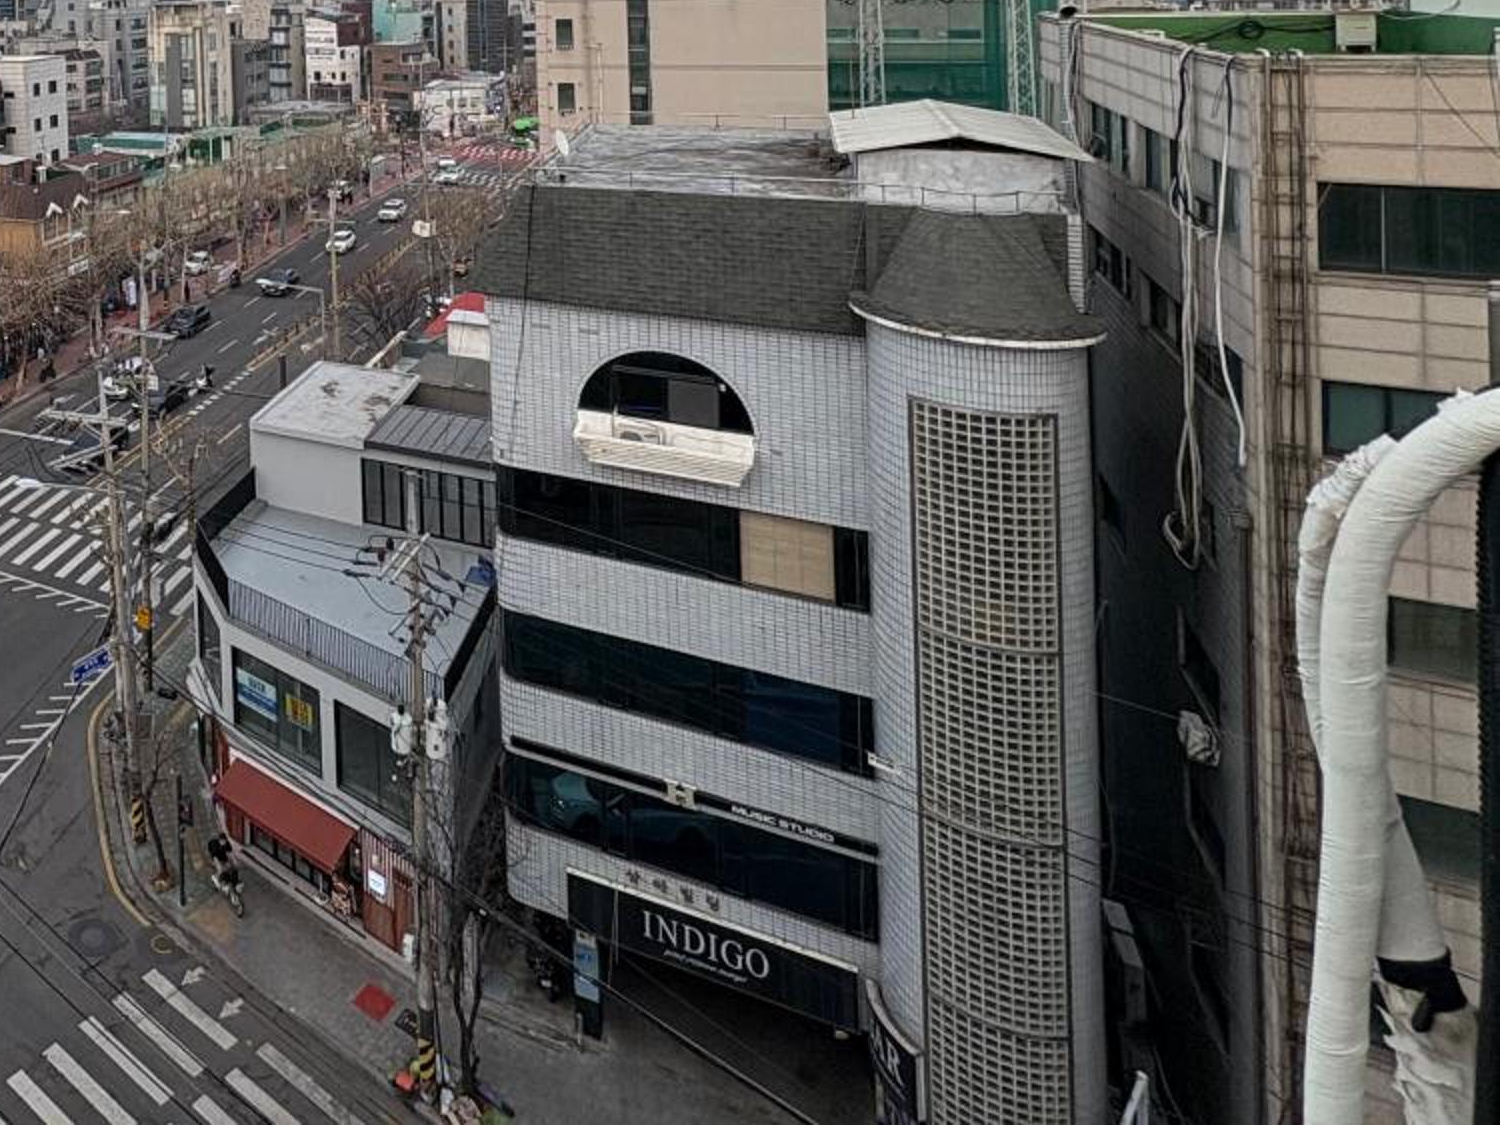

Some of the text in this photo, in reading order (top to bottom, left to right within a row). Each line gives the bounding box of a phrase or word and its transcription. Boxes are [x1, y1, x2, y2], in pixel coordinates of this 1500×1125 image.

[731, 805, 778, 827] MUSIC
[778, 820, 835, 844] STUDIO
[643, 911, 770, 979] INDIGO
